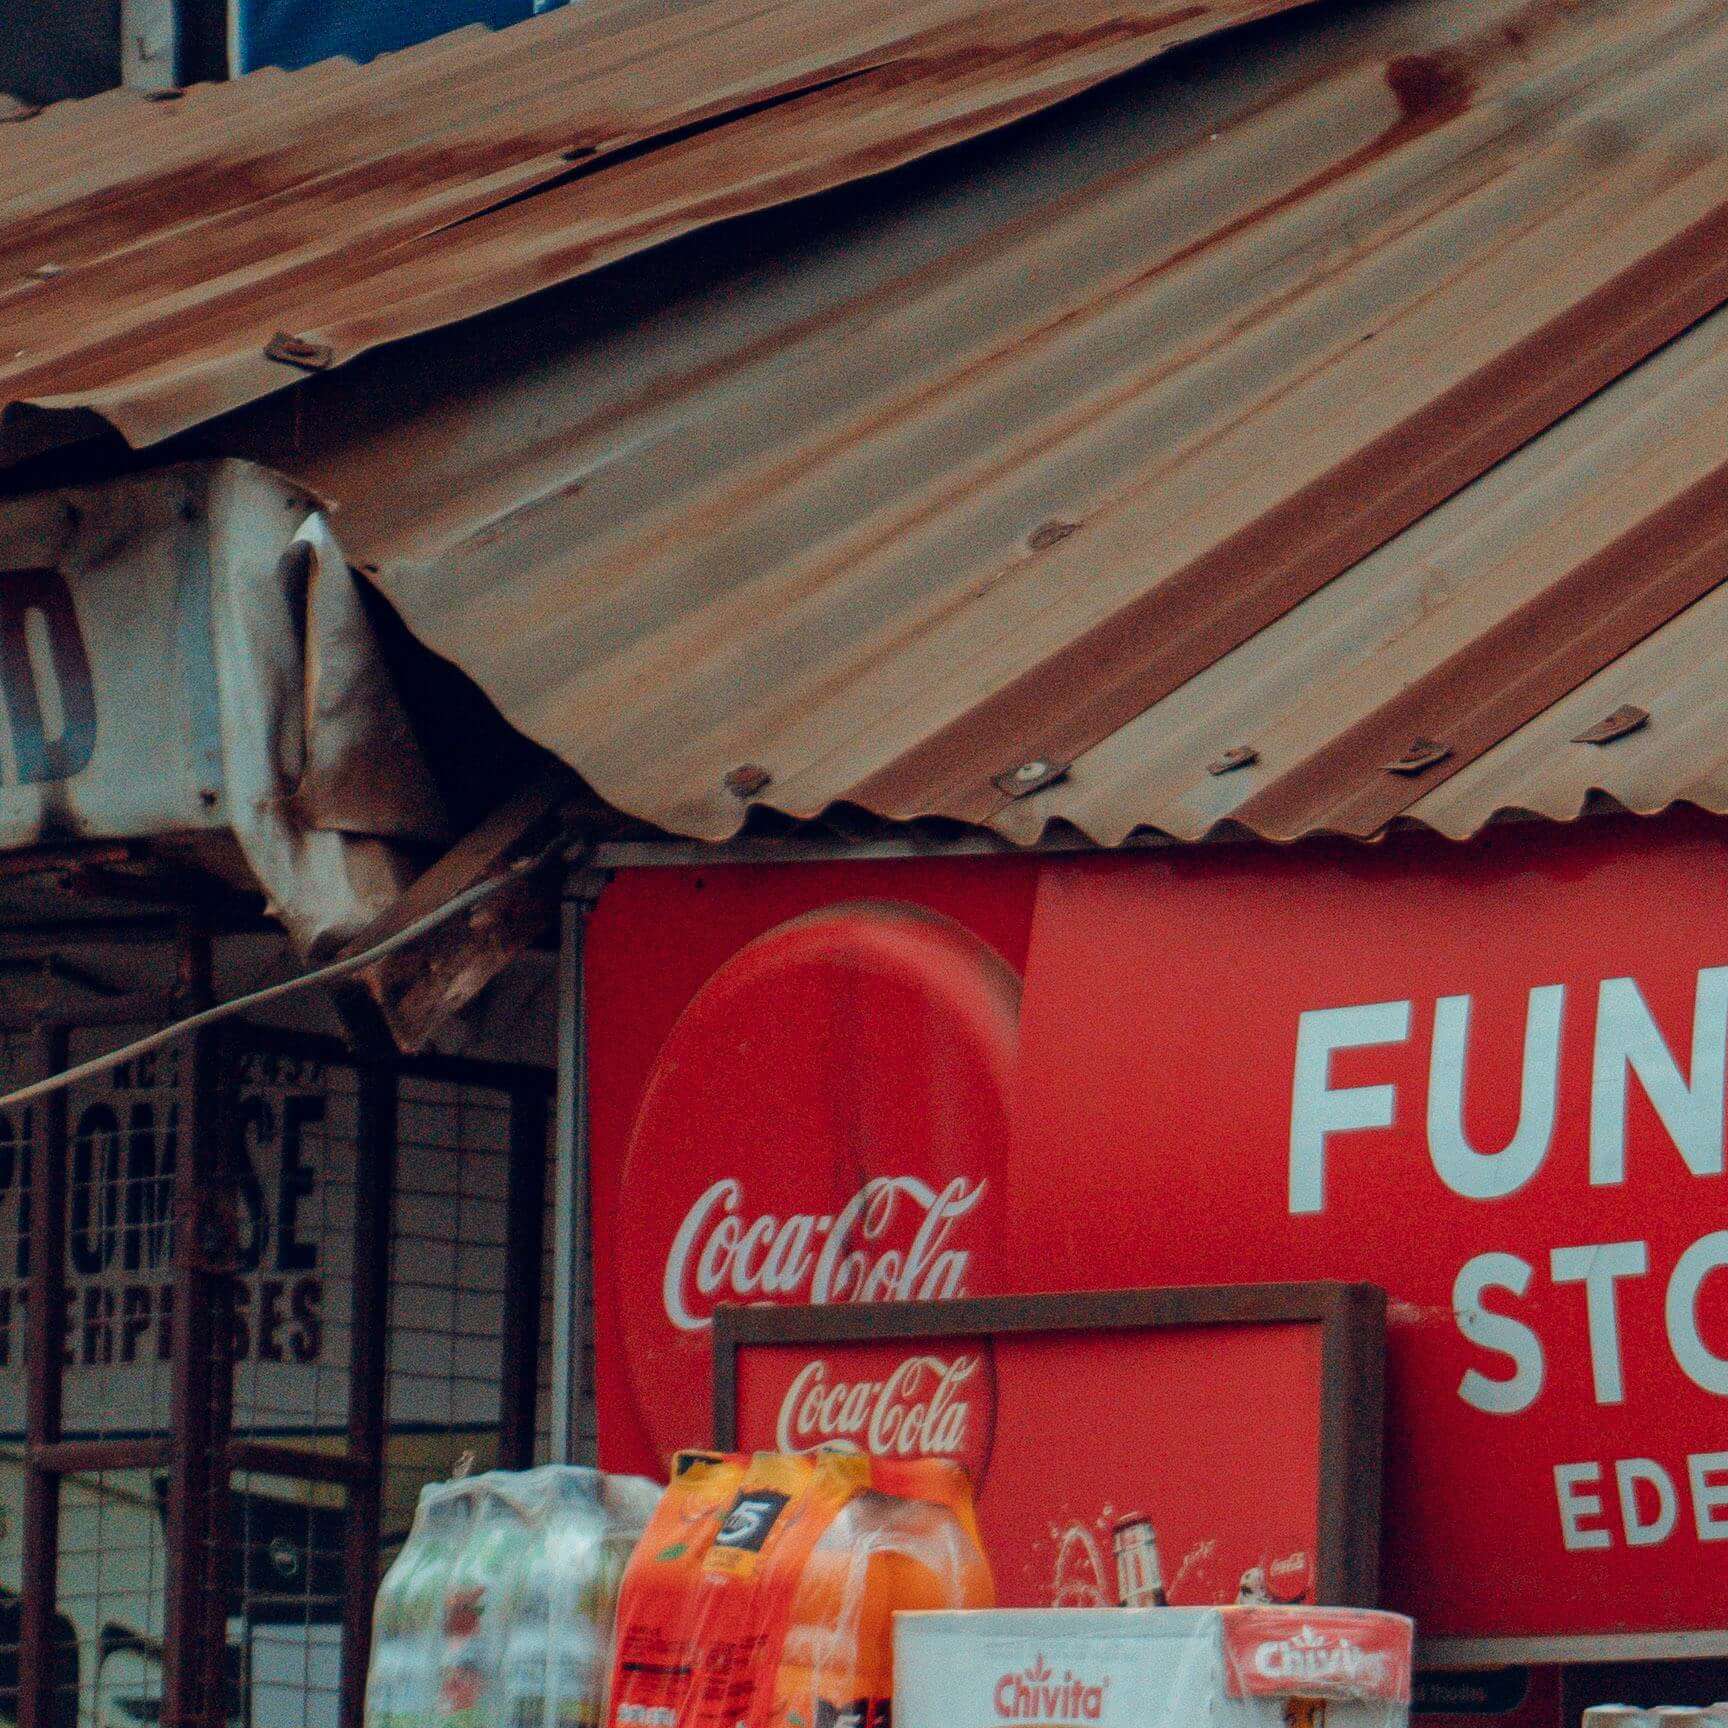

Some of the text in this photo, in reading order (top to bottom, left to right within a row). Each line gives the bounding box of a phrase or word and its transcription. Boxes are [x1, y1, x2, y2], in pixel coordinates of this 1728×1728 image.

[662, 1175, 988, 1331] Coca-Cola
[776, 1355, 980, 1459] Coca-Cola
[993, 1660, 1104, 1720] Chivita
